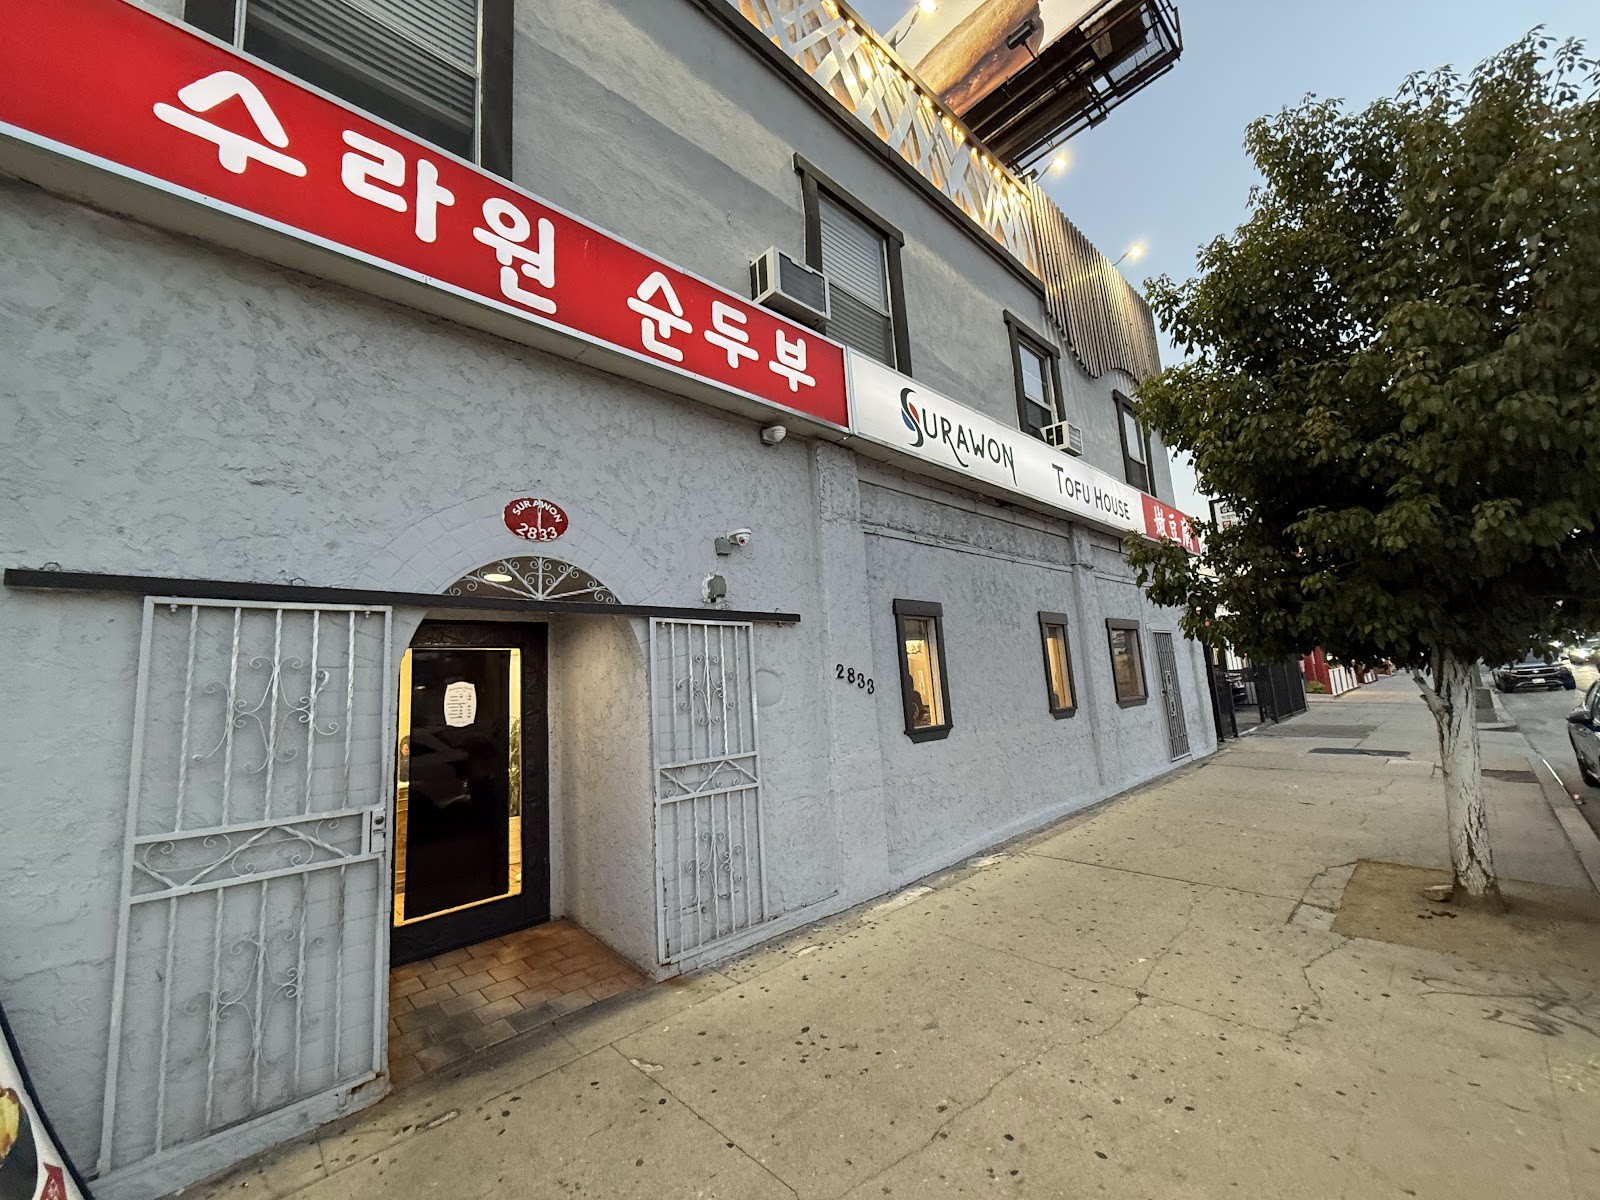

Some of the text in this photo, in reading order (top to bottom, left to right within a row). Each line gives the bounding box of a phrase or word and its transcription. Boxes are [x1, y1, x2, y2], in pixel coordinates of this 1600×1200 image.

[153, 71, 816, 392] 수라원 순두부
[900, 388, 1130, 520] SURAWON TOFU HOUSE
[512, 499, 562, 523] SURAWON
[516, 522, 558, 540] 2833
[836, 664, 875, 694] 2833
